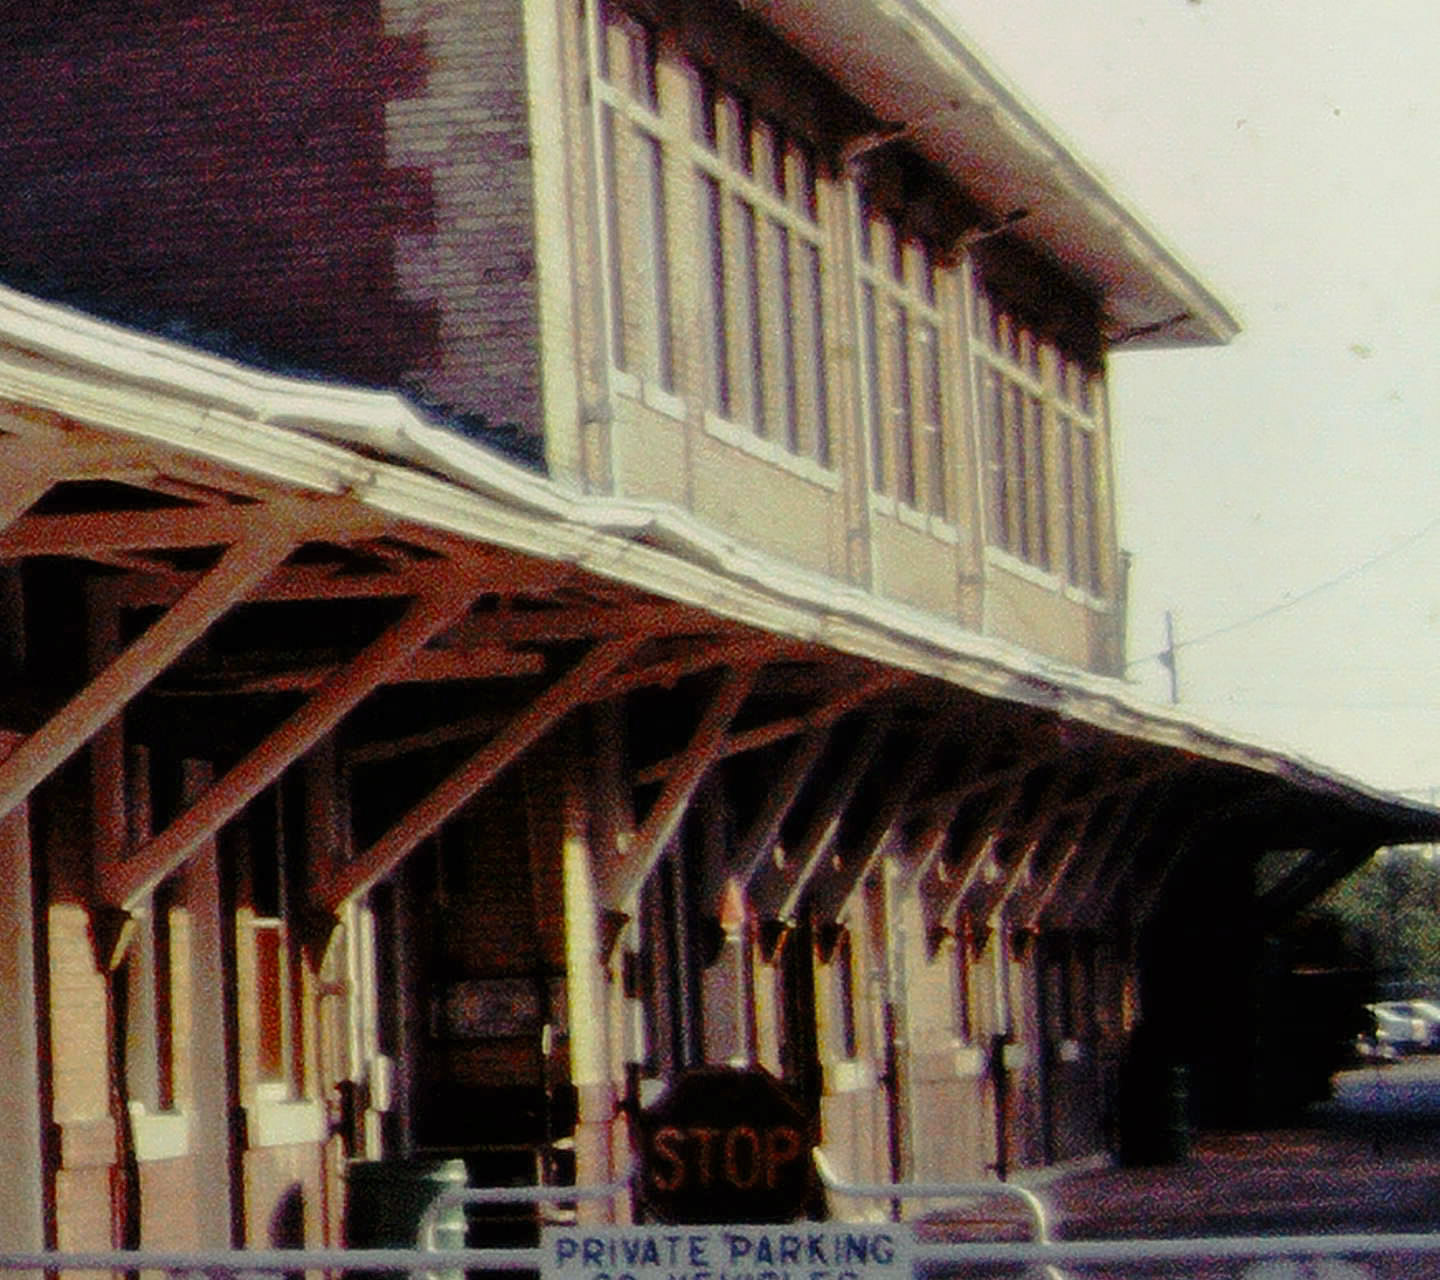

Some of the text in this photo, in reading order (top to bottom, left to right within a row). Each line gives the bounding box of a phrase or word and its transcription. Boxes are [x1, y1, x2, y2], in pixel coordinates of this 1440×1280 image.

[655, 1126, 801, 1190] STOP
[556, 1233, 894, 1269] PRIVATE PARKING
